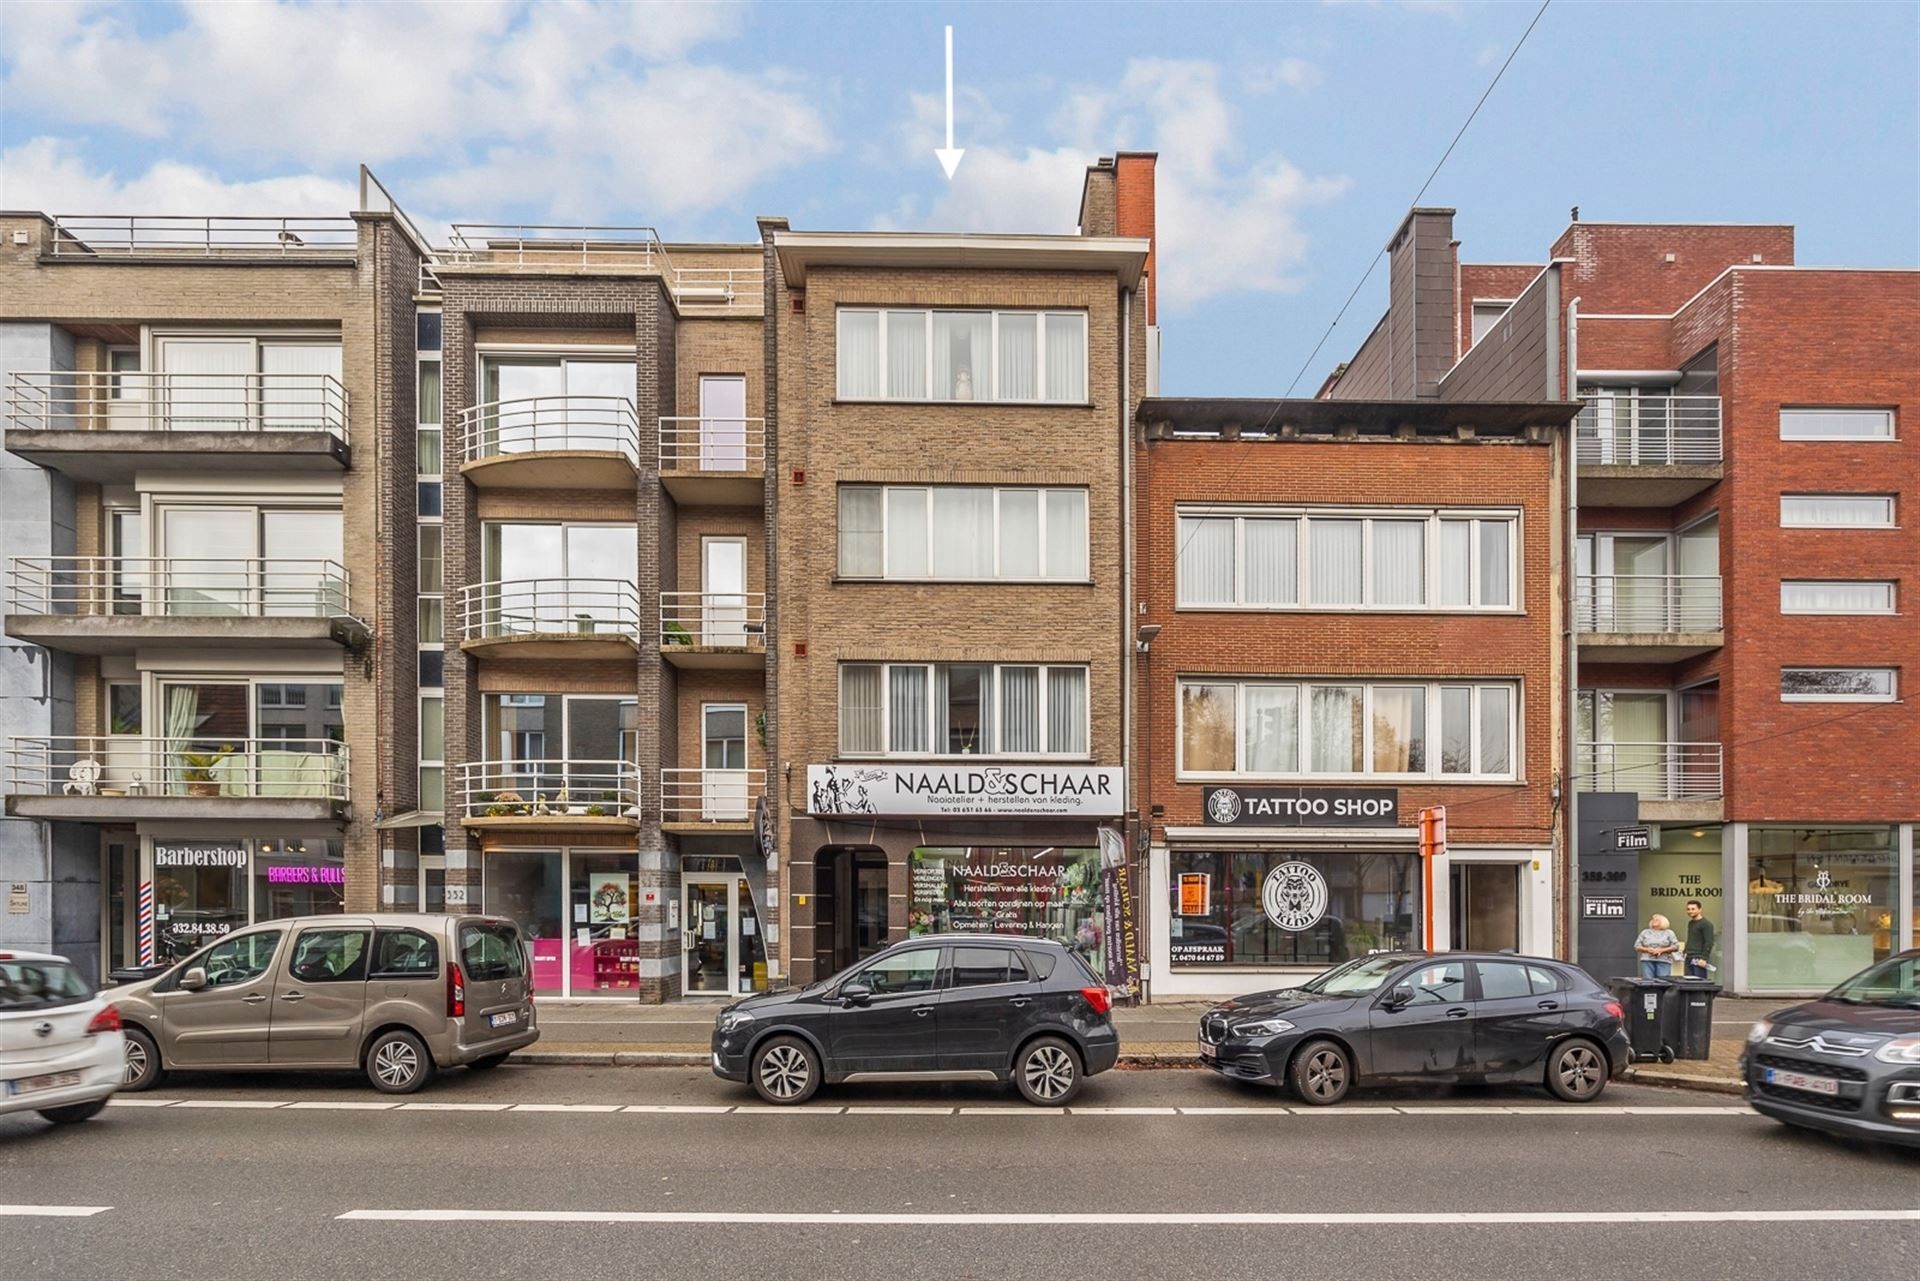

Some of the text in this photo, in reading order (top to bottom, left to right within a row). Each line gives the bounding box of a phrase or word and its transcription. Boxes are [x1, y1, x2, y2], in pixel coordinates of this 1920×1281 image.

[988, 795, 1030, 804] herstellen
[1050, 795, 1084, 807] kleding.
[1244, 798, 1394, 816] TATTOO SHOP
[1617, 835, 1648, 848] Film
[155, 847, 247, 868] Barbershop
[268, 866, 310, 883] BARBERS
[311, 867, 319, 883] &
[1271, 864, 1317, 883] TATTOO
[1678, 874, 1702, 885] THE
[963, 884, 1000, 893] Herstellen
[1001, 885, 1015, 893] van
[1030, 884, 1057, 895] kleding
[1650, 887, 1695, 897] BRIDAL
[953, 899, 967, 908] Alle
[968, 899, 997, 908] soorten
[998, 899, 1034, 909] gordijnen
[1034, 900, 1046, 909] op
[1774, 894, 1872, 904] THE BRIDAL ROOM
[1586, 902, 1623, 915] Film
[995, 910, 1018, 919] Gratis
[1276, 912, 1315, 927] KLIDI
[952, 920, 989, 930] Opmeten
[994, 920, 1028, 930] Levering
[1029, 921, 1035, 929] &
[1035, 921, 1065, 930] Hangen
[1171, 945, 1225, 953] OP AFSPRAAK
